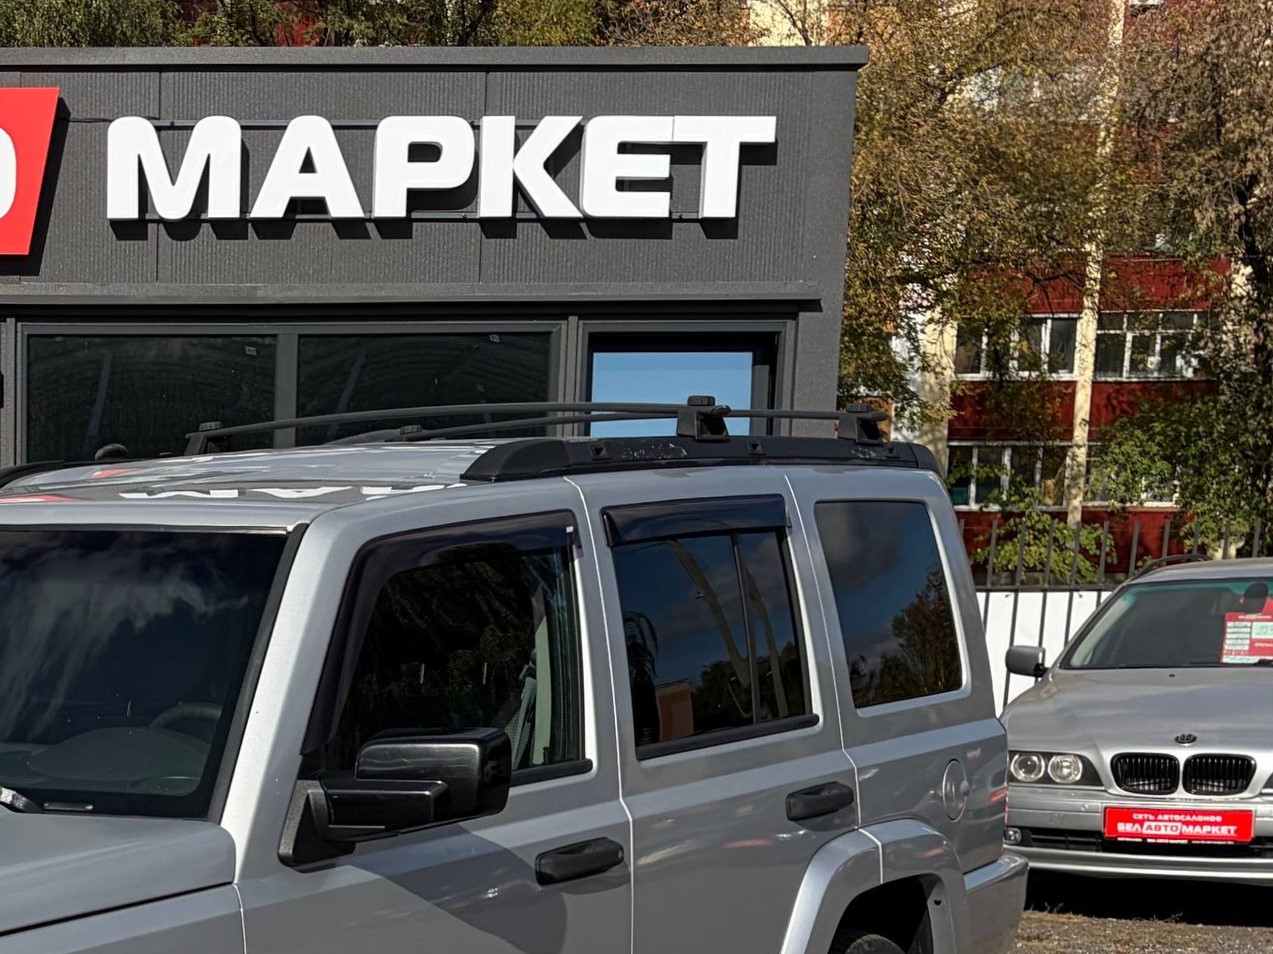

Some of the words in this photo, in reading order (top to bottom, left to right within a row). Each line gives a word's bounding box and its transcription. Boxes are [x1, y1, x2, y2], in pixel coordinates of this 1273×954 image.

[107, 115, 777, 220] МАРКЕТ
[1145, 824, 1179, 833] АВТО
[1182, 824, 1237, 835] МАРКЕТ
